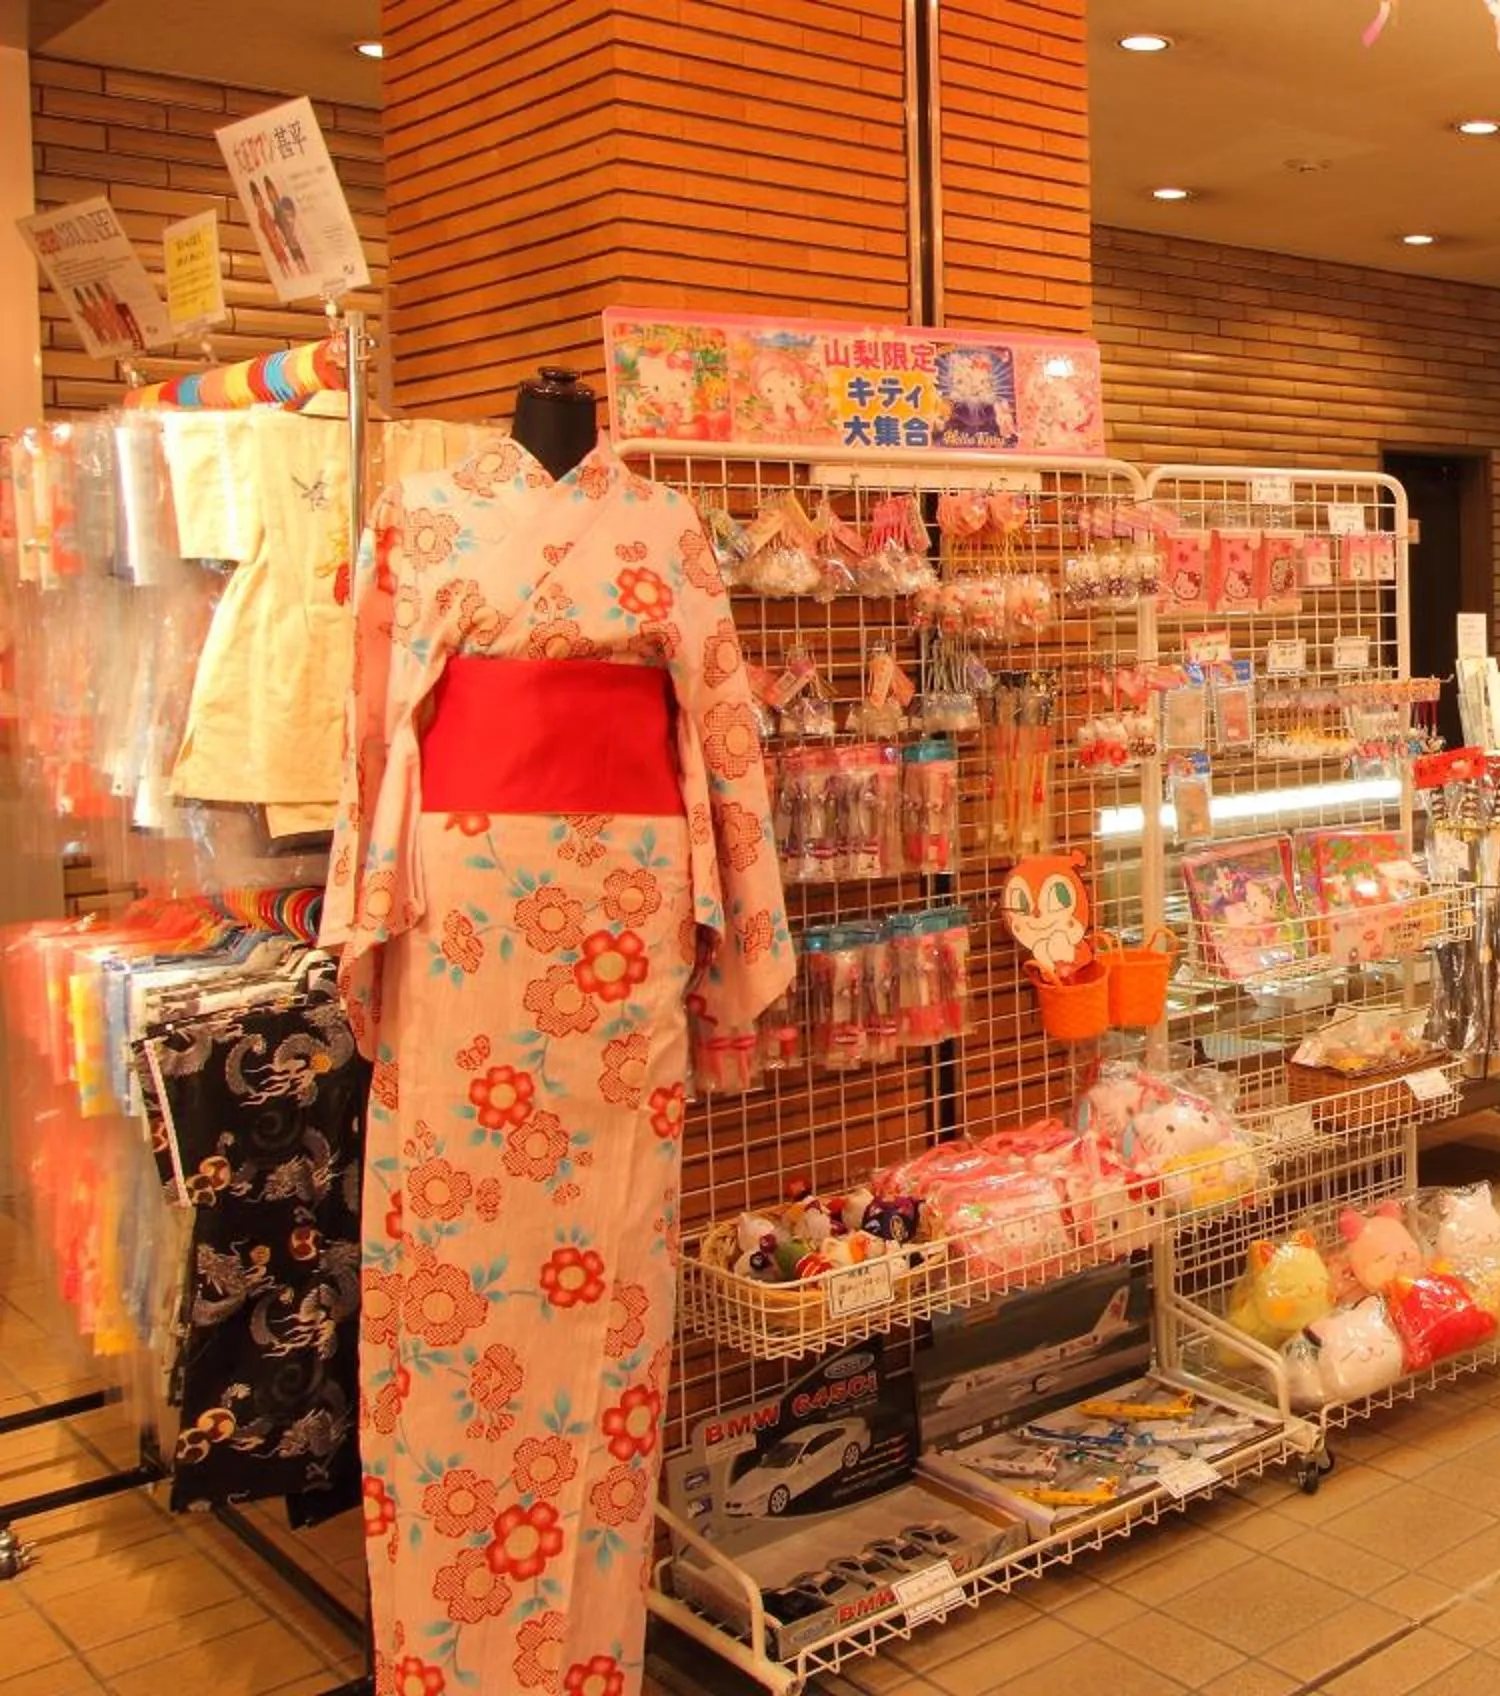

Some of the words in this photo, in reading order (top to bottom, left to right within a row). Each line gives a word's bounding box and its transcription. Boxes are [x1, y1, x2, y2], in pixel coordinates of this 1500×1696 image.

[826, 340, 937, 373] 山梨限定
[847, 377, 922, 410] キティ
[843, 414, 932, 448] 大集合
[704, 1404, 780, 1445] BMW
